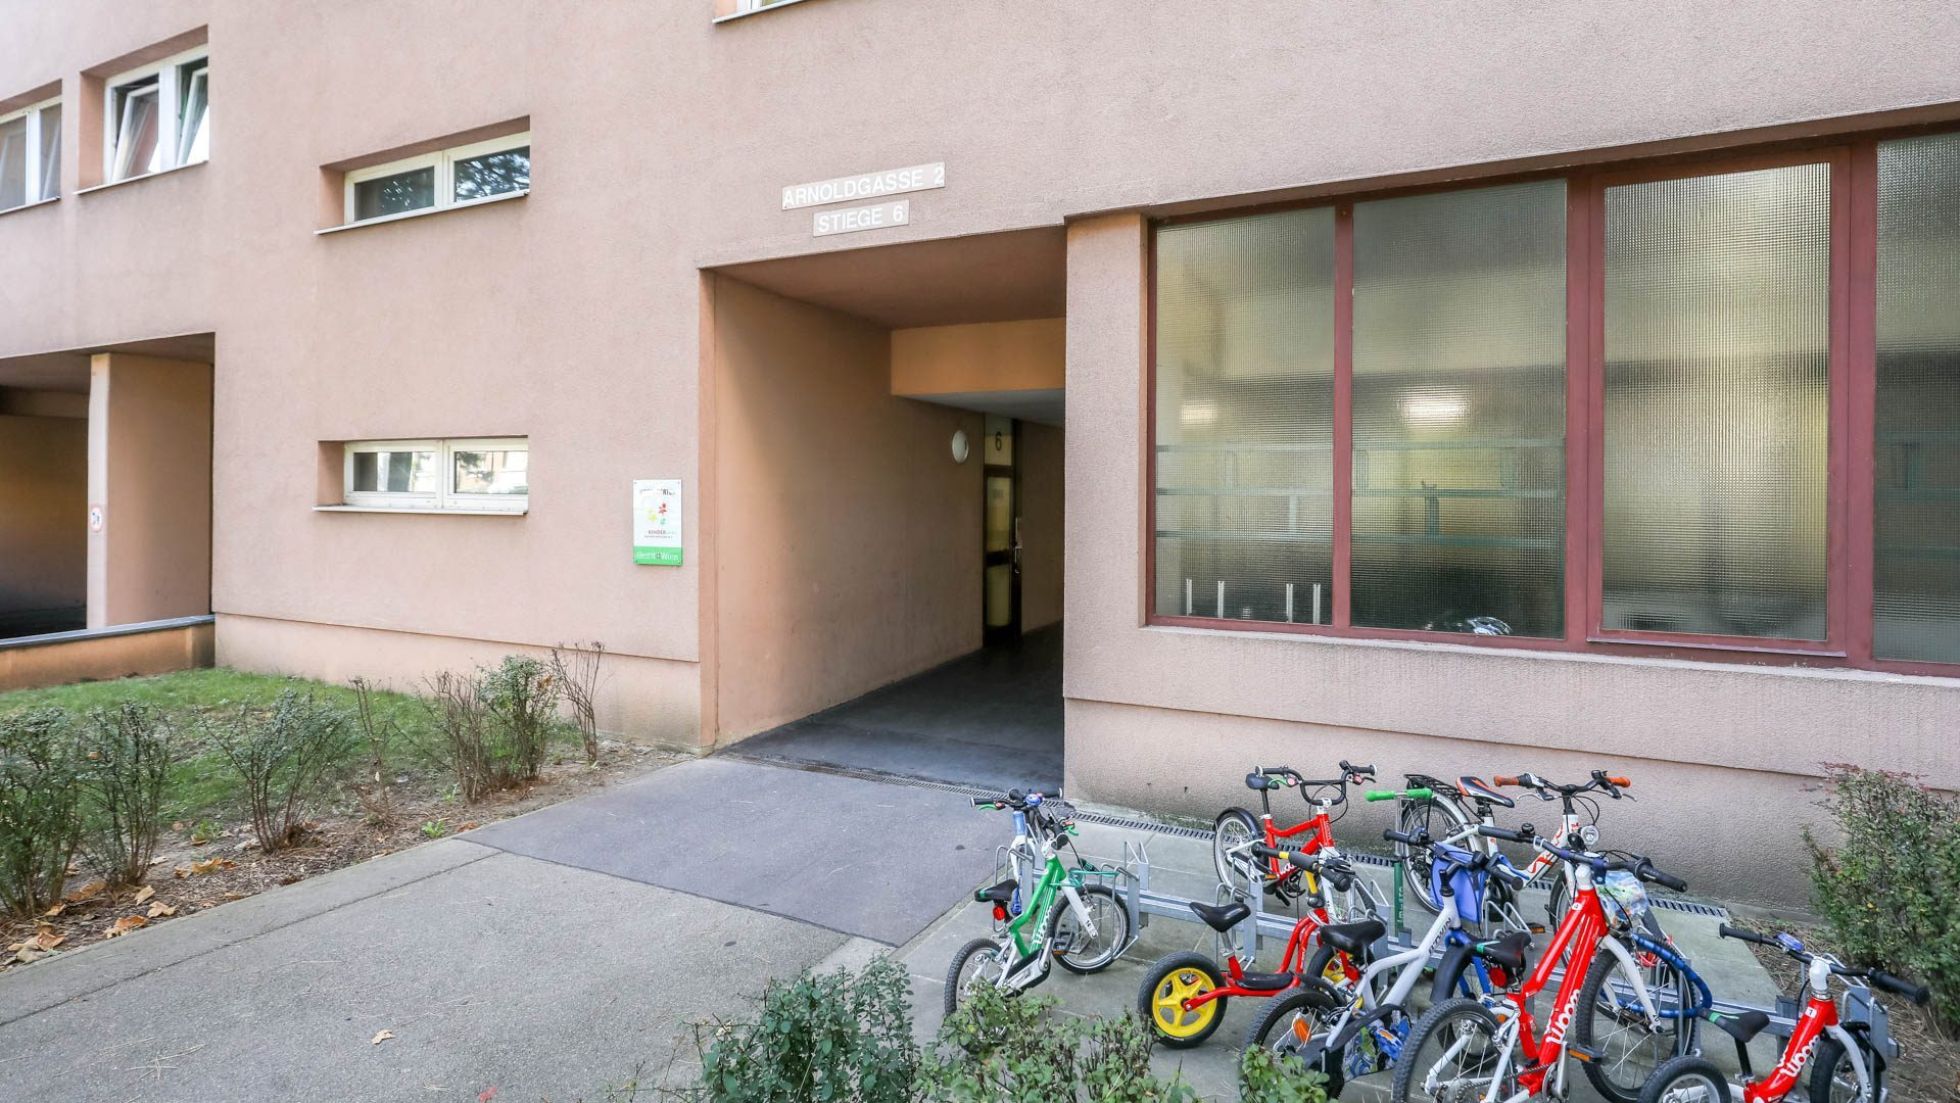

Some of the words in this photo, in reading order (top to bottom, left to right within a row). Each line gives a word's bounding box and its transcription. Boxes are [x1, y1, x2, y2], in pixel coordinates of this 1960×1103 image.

[783, 169, 924, 206] ARNOLDGASSE
[934, 166, 944, 185] 2
[818, 207, 882, 233] STIEGE
[893, 205, 903, 222] 6
[995, 431, 1002, 451] 6
